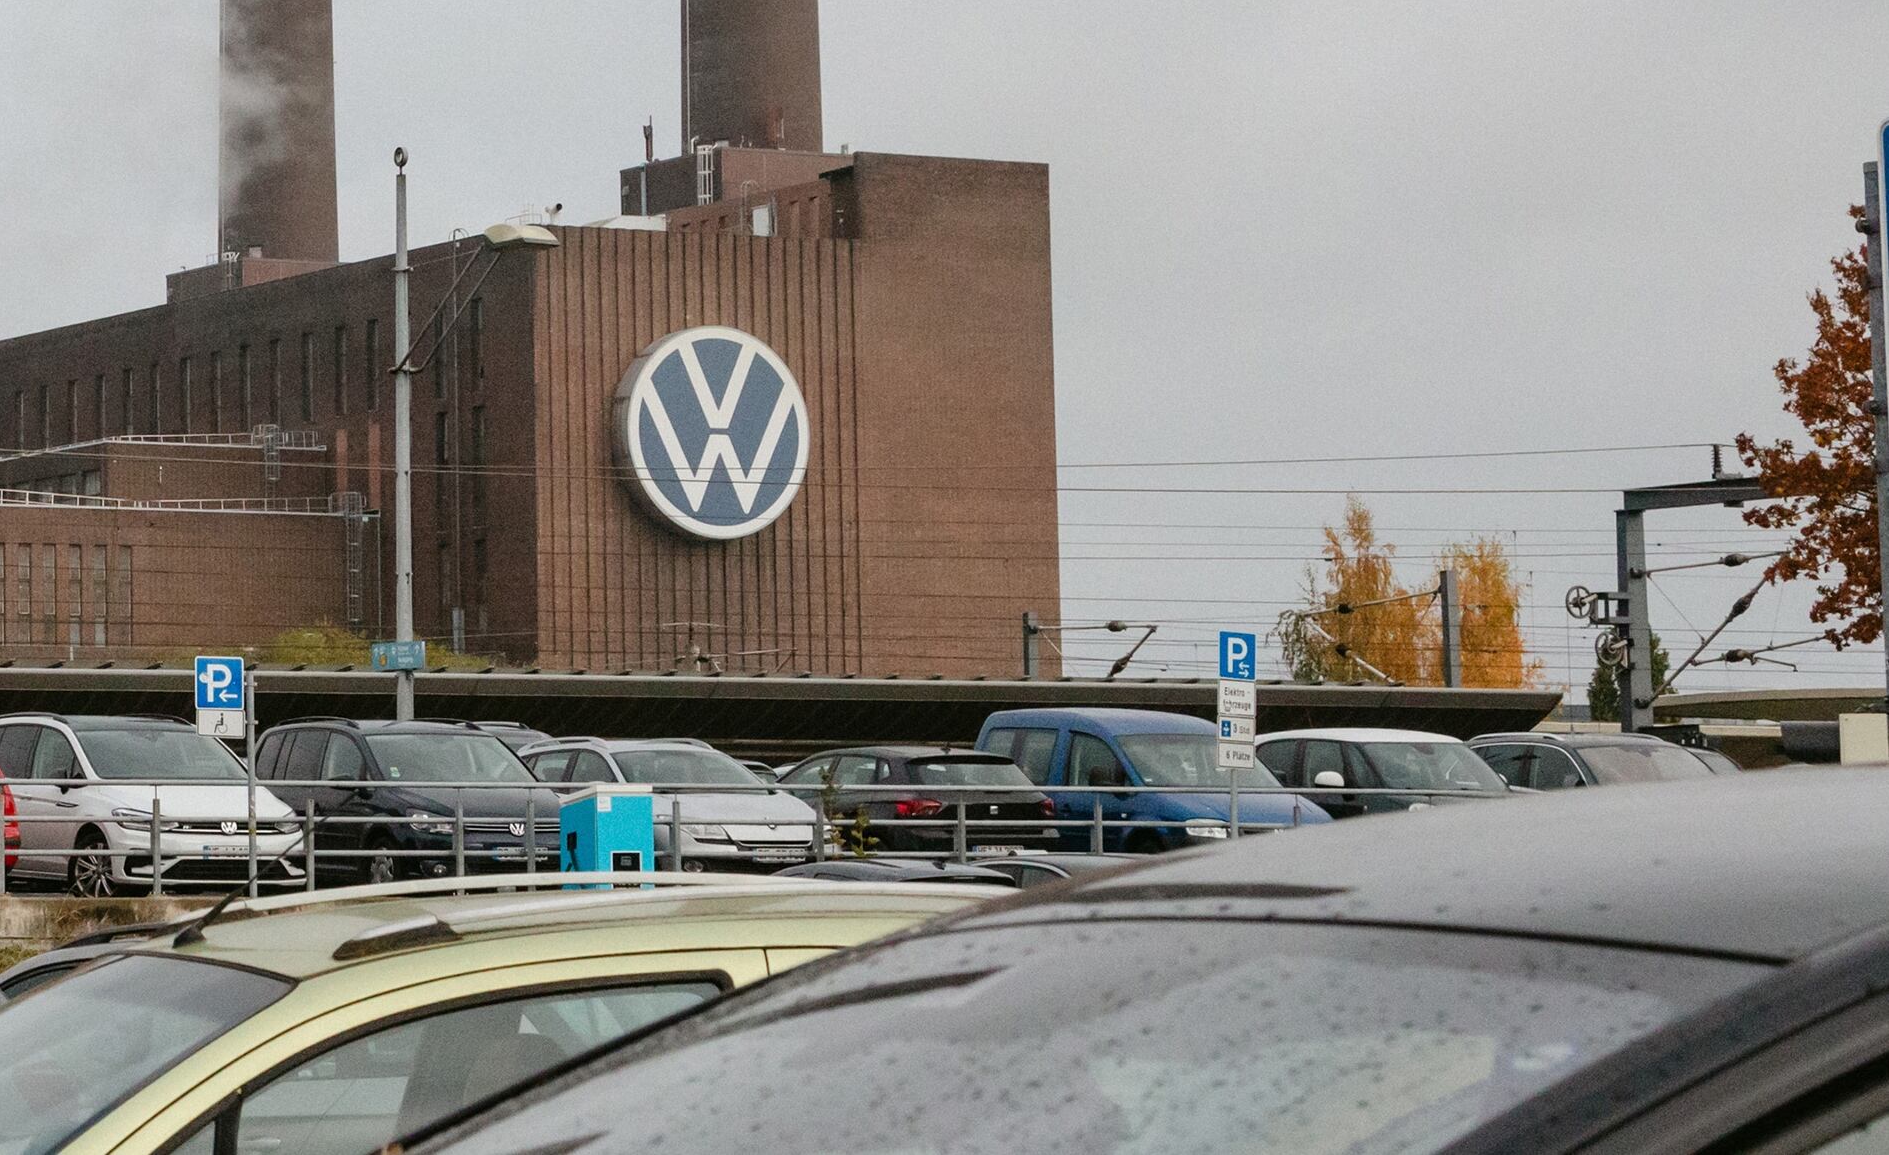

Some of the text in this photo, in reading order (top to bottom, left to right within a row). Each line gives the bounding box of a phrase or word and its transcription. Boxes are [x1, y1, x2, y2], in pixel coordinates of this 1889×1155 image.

[638, 338, 798, 517] VW
[1227, 636, 1248, 673] P
[206, 663, 233, 703] P
